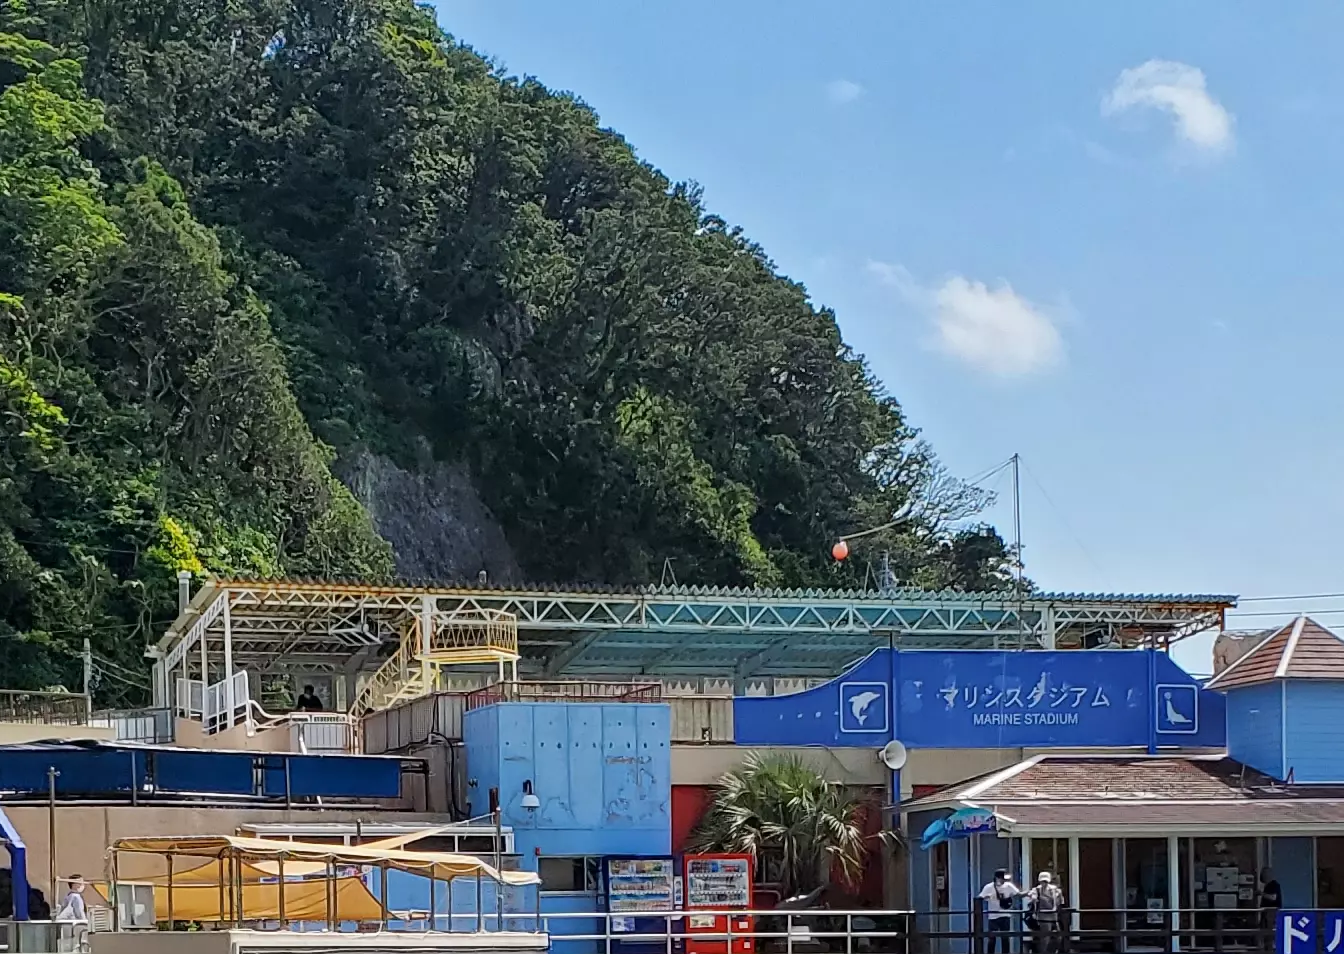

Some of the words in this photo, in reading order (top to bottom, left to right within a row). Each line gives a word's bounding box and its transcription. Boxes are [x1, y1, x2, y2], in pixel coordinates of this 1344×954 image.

[939, 686, 1111, 709] マリンスタジアム
[973, 713, 1021, 726] MARINE
[1024, 712, 1079, 726] STADIUM
